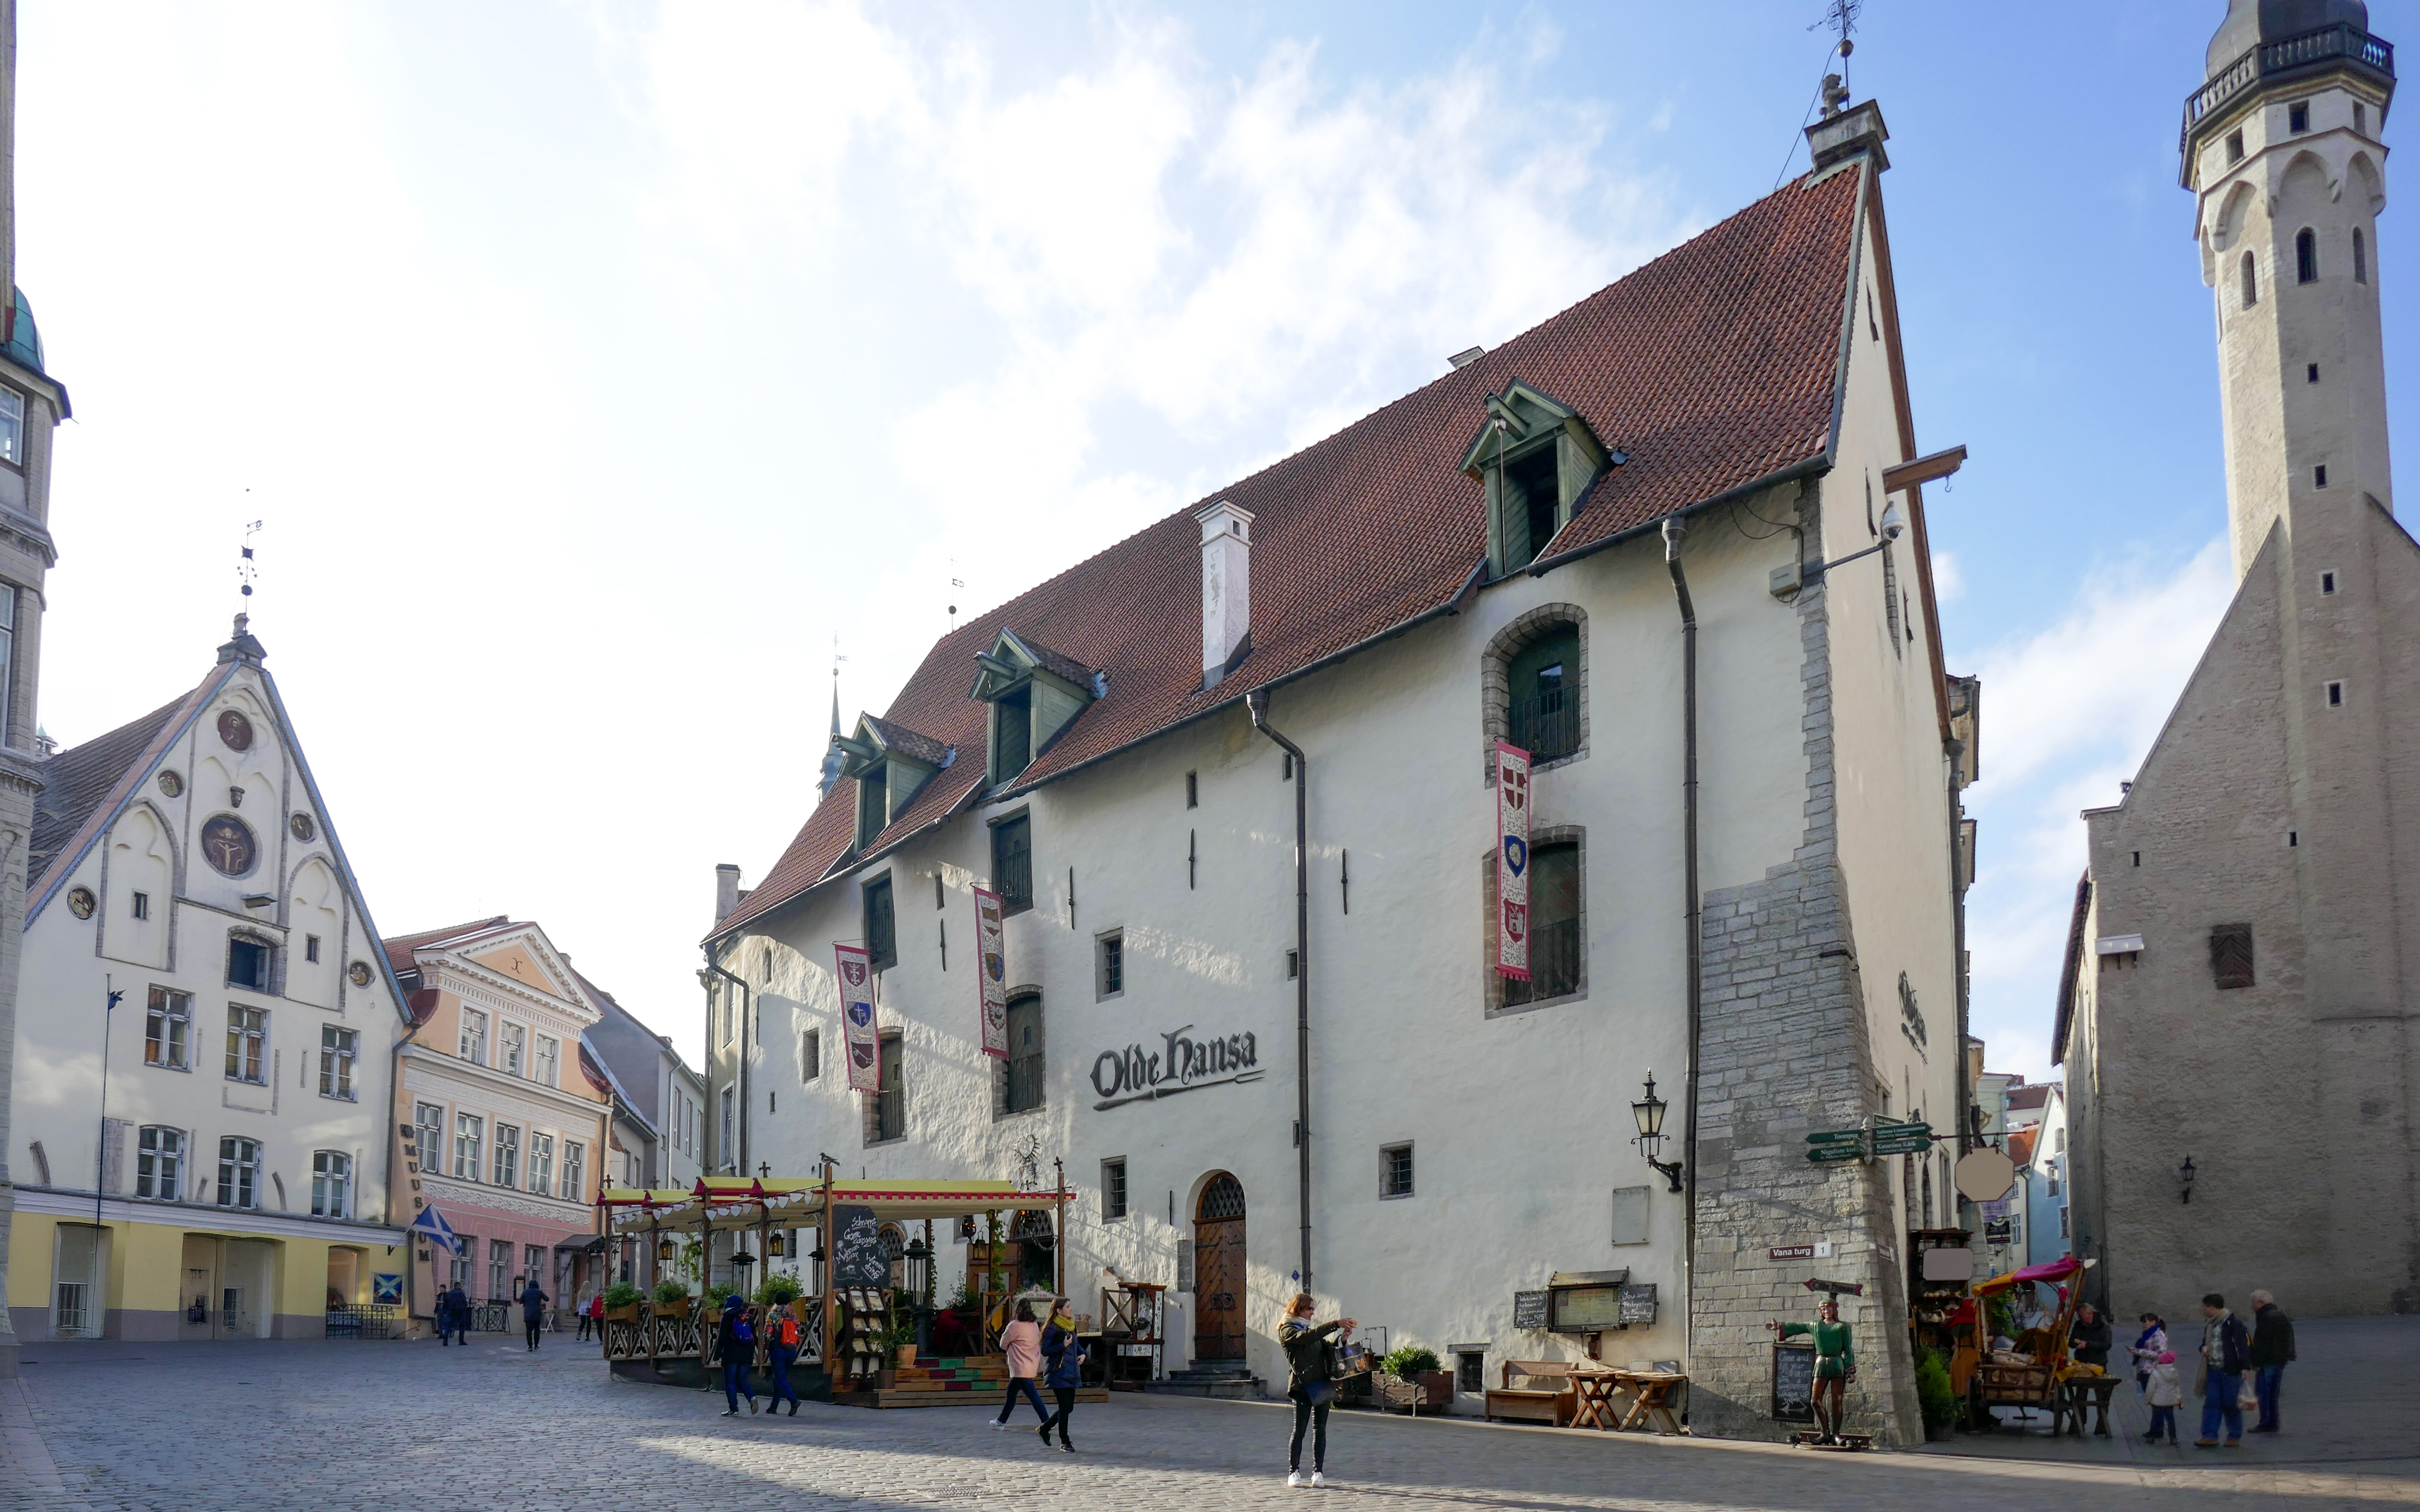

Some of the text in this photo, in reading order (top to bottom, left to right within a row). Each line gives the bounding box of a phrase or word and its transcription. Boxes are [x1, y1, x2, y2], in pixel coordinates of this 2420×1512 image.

[844, 984, 871, 995] DANZIG
[1090, 1024, 1257, 1097] Olde Hansa
[852, 1066, 877, 1079] BREMEN
[404, 1144, 431, 1262] MUUSUM
[843, 1228, 861, 1240] Game
[1773, 1248, 1792, 1256] Vana
[1794, 1247, 1810, 1255] turg
[1622, 1291, 1635, 1299] You
[1778, 1351, 1809, 1362] Come and
